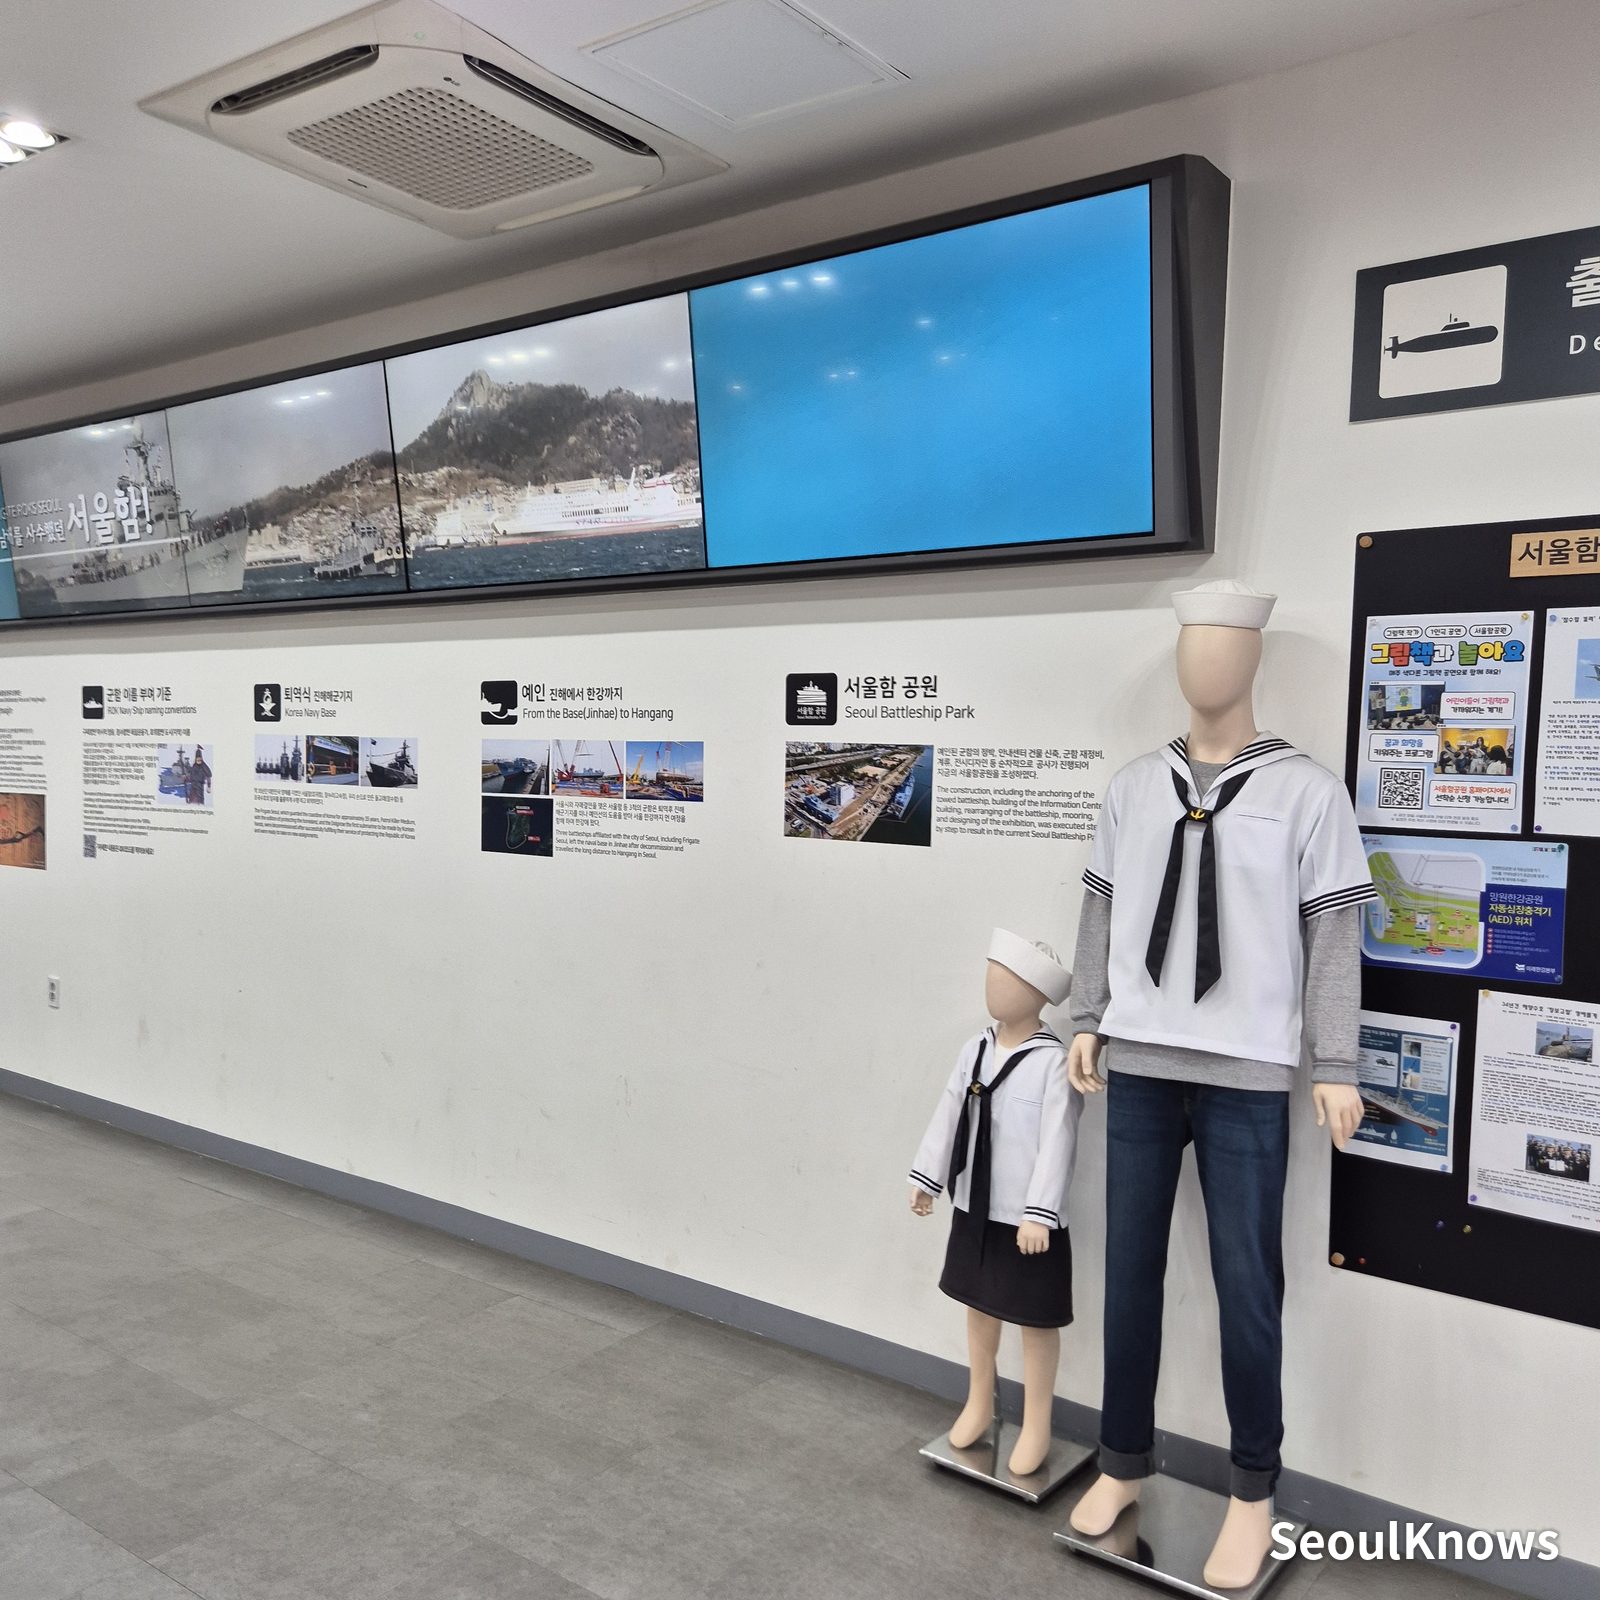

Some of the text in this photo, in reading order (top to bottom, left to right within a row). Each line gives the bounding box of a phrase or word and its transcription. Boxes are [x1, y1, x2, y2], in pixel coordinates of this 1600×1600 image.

[67, 486, 152, 546] 서울함!
[1517, 535, 1600, 566] 서울함
[1371, 641, 1454, 666] 그림책과
[522, 683, 623, 702] 예인 진해에서 한강까지
[844, 675, 937, 698] 서울함 공원
[106, 687, 171, 702] 군함 이름 부여 기준
[284, 687, 352, 702] 퇴역식 진해해군기지
[132, 706, 144, 716] Ship
[145, 707, 164, 716] naming
[165, 706, 197, 714] conventions
[284, 708, 336, 719] Korea Navy Base
[523, 707, 674, 721] From the Base(Jinhae) to Hangang
[797, 706, 826, 715] 서울함 공원
[845, 705, 975, 721] Seoul Battleship Park
[1401, 739, 1423, 747] 희망을
[999, 748, 1026, 758] 안내센터
[1029, 749, 1042, 758] 건물
[1045, 749, 1061, 758] 신축,
[1063, 750, 1078, 759] 군함
[1080, 750, 1104, 759] 재정비,
[1405, 750, 1433, 758] 프로그램
[999, 759, 1033, 768] 순차적으로
[1036, 760, 1058, 769] 공사가
[1060, 761, 1089, 770] 진행되어
[1001, 770, 1038, 779] 조성하였다.
[937, 785, 948, 793] The
[950, 787, 992, 795] construction,
[994, 788, 1023, 797] including
[1037, 790, 1072, 799] anchoring
[1074, 790, 1081, 798] of
[958, 797, 990, 806] battleship,
[992, 798, 1018, 808] building
[1040, 800, 1080, 809] Information
[964, 808, 1002, 817] rearranging
[1025, 809, 1061, 819] battleship,
[1062, 812, 1094, 821] mooring,
[949, 817, 980, 826] designing
[1002, 819, 1036, 828] exhibition,
[1053, 822, 1085, 830] executed
[661, 836, 682, 844] including
[683, 837, 700, 845] Frigate
[1031, 830, 1050, 838] Seoul
[1052, 831, 1086, 841] Battleship
[640, 843, 673, 851] decommission
[617, 850, 637, 858] Hangang
[1489, 892, 1543, 905] 망원한강공원
[1489, 904, 1552, 917] 자동심장충격기
[1488, 914, 1532, 926] (AED) 위치
